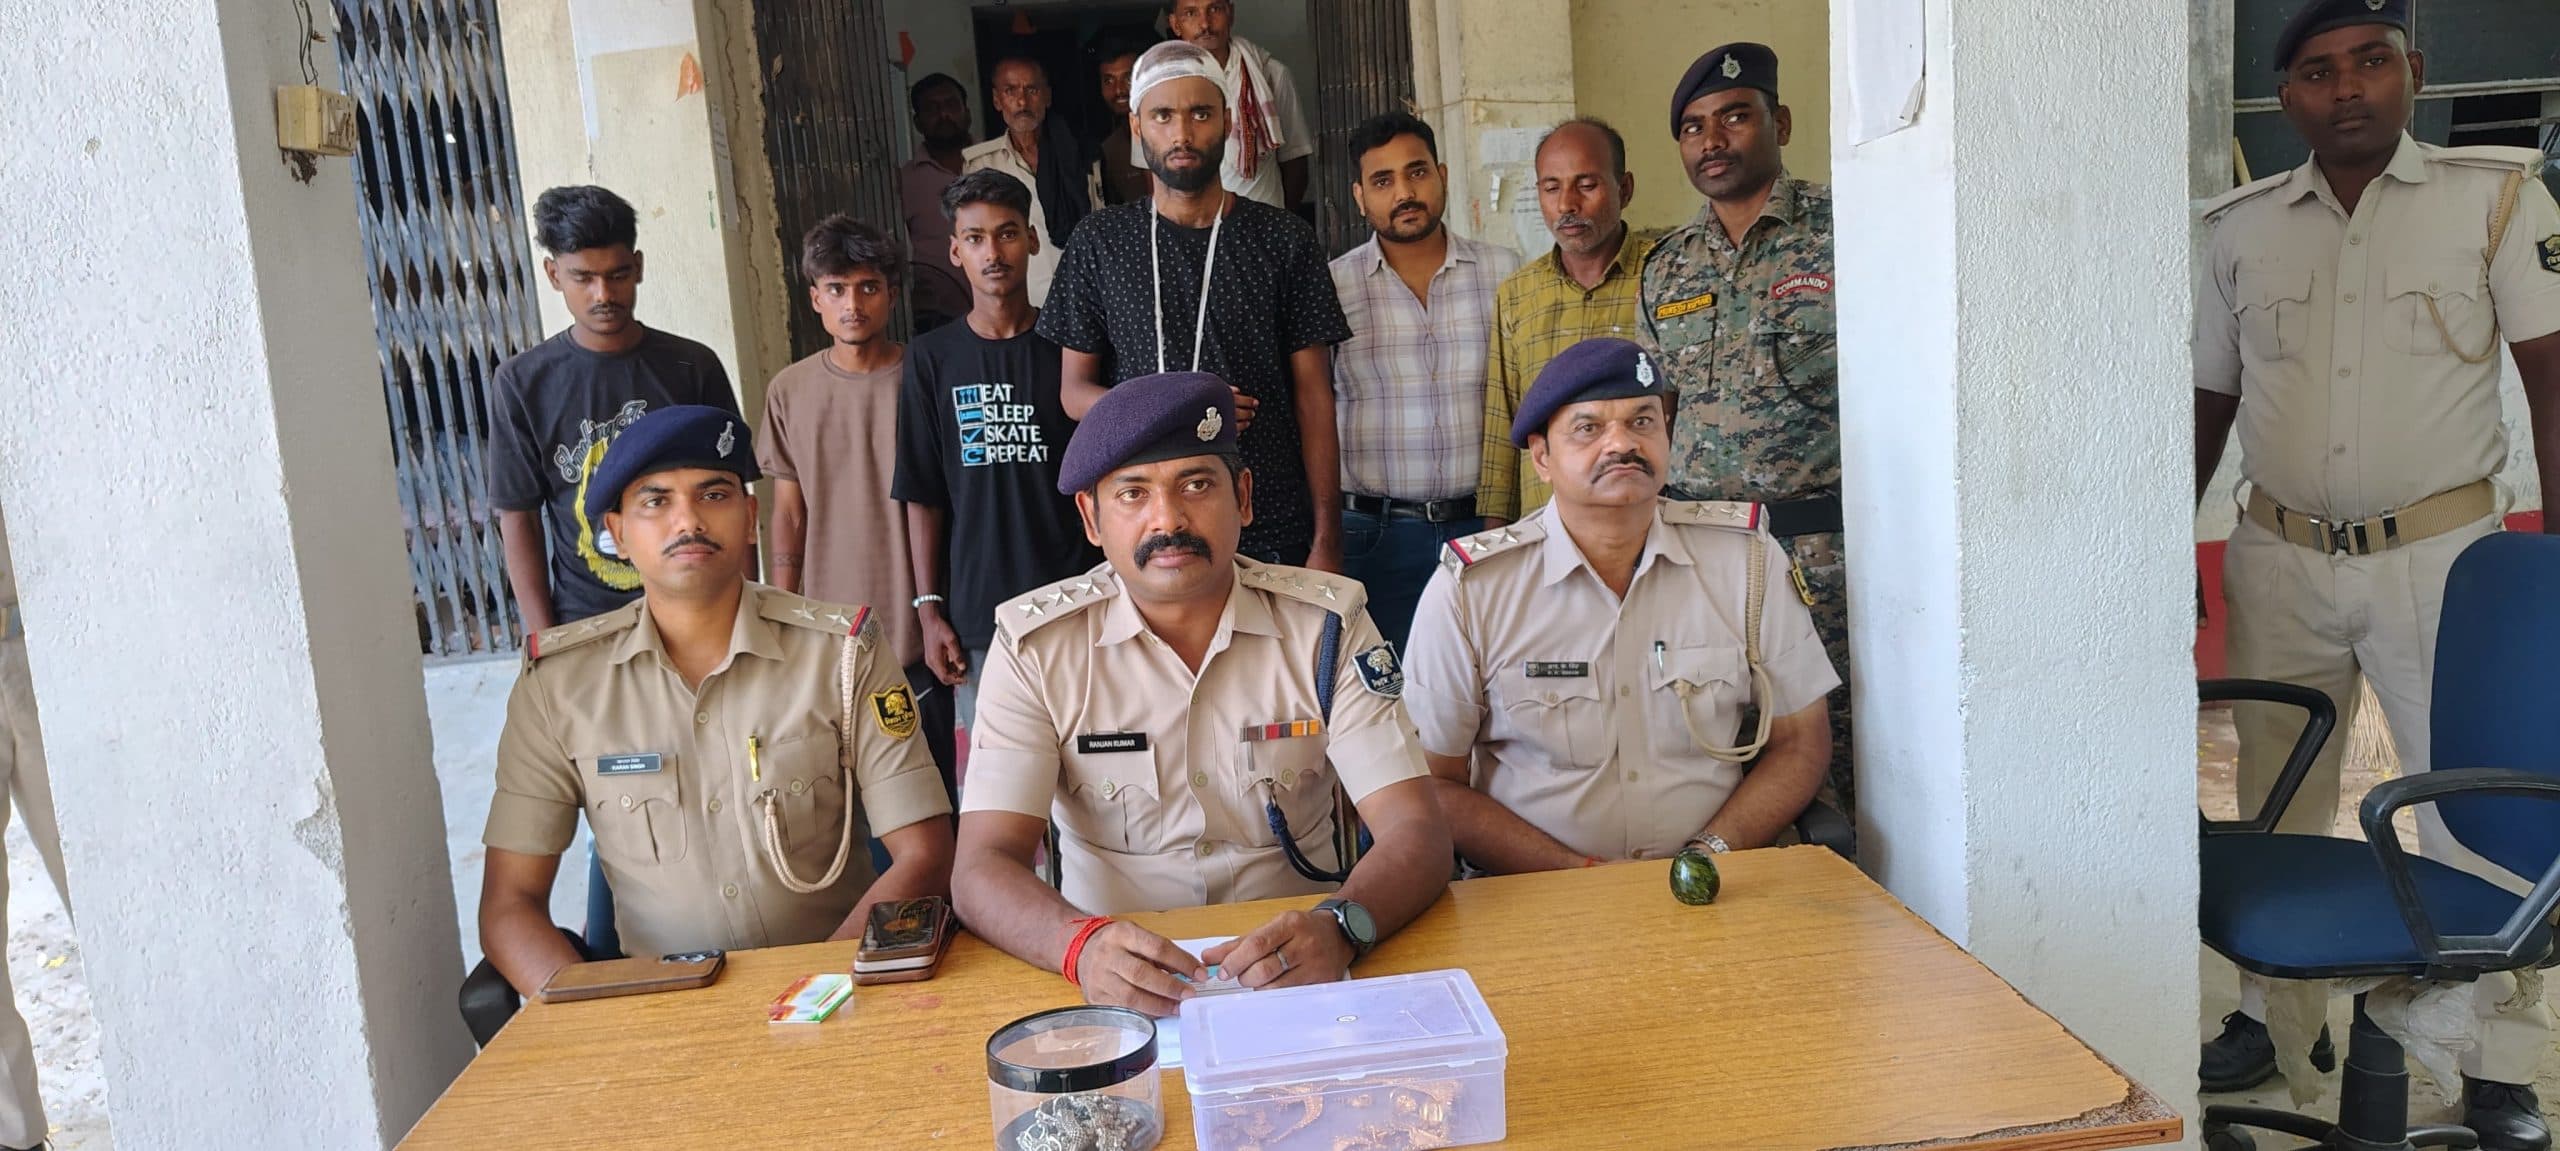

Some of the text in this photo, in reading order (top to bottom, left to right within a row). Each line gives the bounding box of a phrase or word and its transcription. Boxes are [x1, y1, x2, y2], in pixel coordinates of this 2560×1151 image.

[1775, 276, 1828, 296] COMMANDO
[982, 383, 1014, 402] EAT
[985, 404, 1035, 423] SLEEP
[987, 424, 1042, 443] SKATE
[988, 444, 1049, 463] REPEAT
[1088, 738, 1136, 749] RANJAN KUMAR
